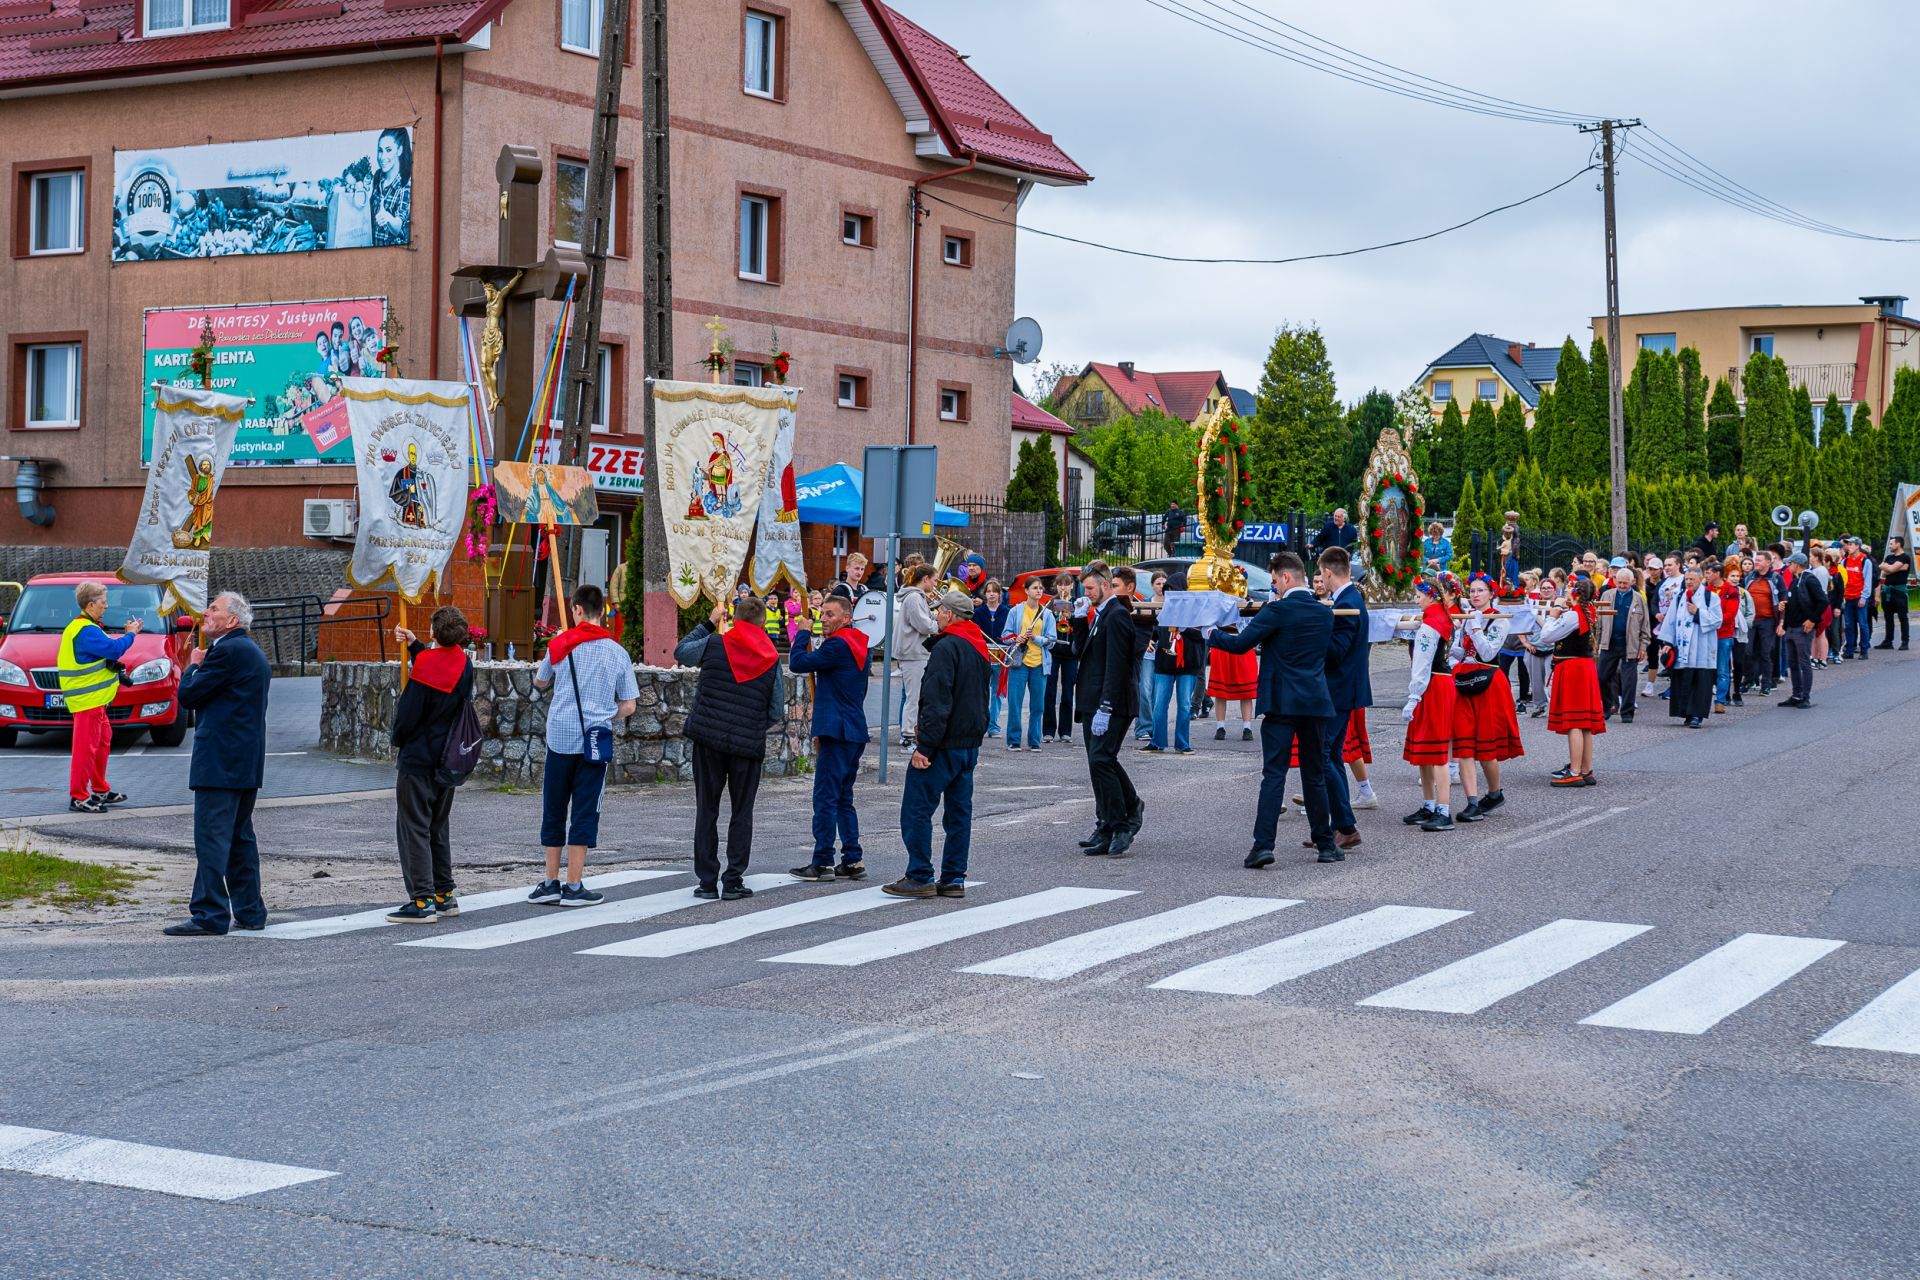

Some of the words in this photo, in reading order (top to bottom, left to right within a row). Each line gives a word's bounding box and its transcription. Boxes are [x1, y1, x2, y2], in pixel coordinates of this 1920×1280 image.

[138, 193, 161, 208] 100%
[277, 309, 338, 327] Justynka
[212, 350, 256, 366] LIENTA
[196, 378, 237, 389] ZKUPY
[245, 417, 286, 429] RABATY
[598, 475, 606, 485] U
